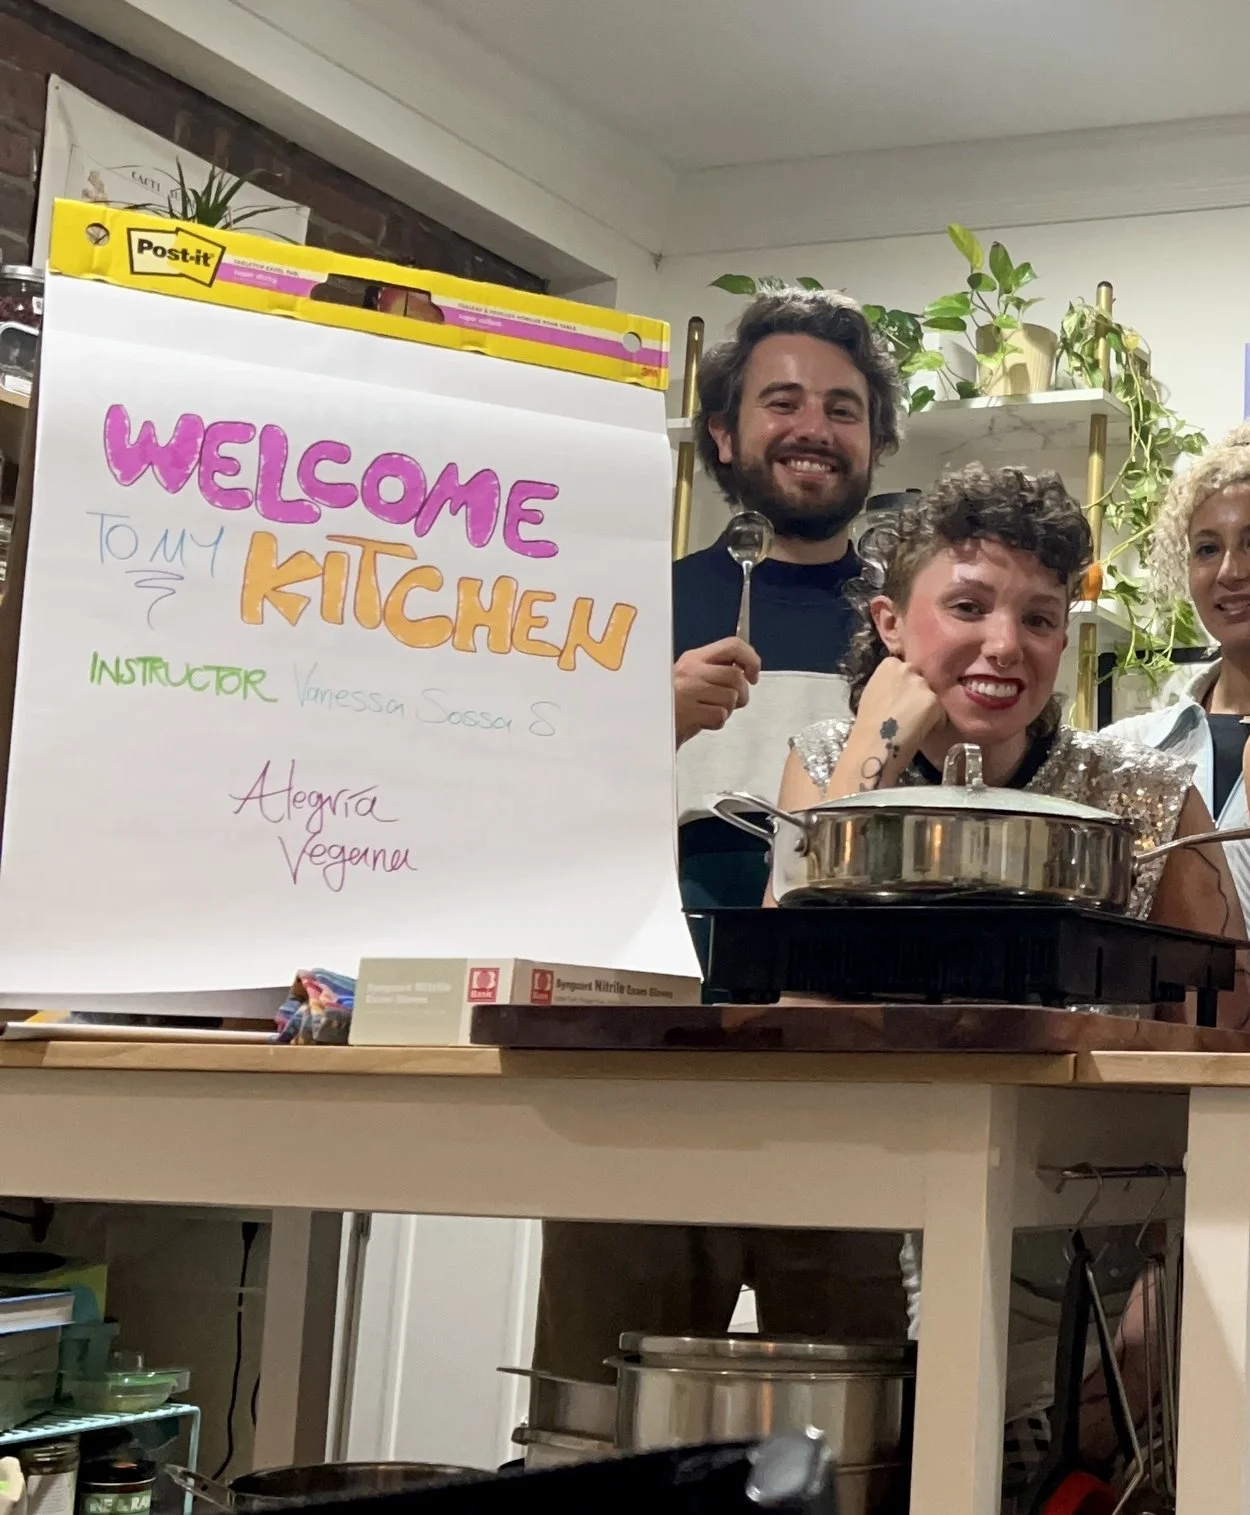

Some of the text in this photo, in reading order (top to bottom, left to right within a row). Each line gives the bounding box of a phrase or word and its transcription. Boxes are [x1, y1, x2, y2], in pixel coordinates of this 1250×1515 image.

[131, 171, 160, 191] CACTI
[137, 238, 211, 267] Post-it
[103, 404, 560, 559] WELCOME
[240, 530, 639, 672] KITCHEN
[88, 650, 279, 704] INSTRUCTOR
[293, 660, 406, 716] Vanessa
[231, 758, 400, 835] Alegría
[277, 833, 420, 892] Vegana
[594, 979, 625, 994] Nitrile
